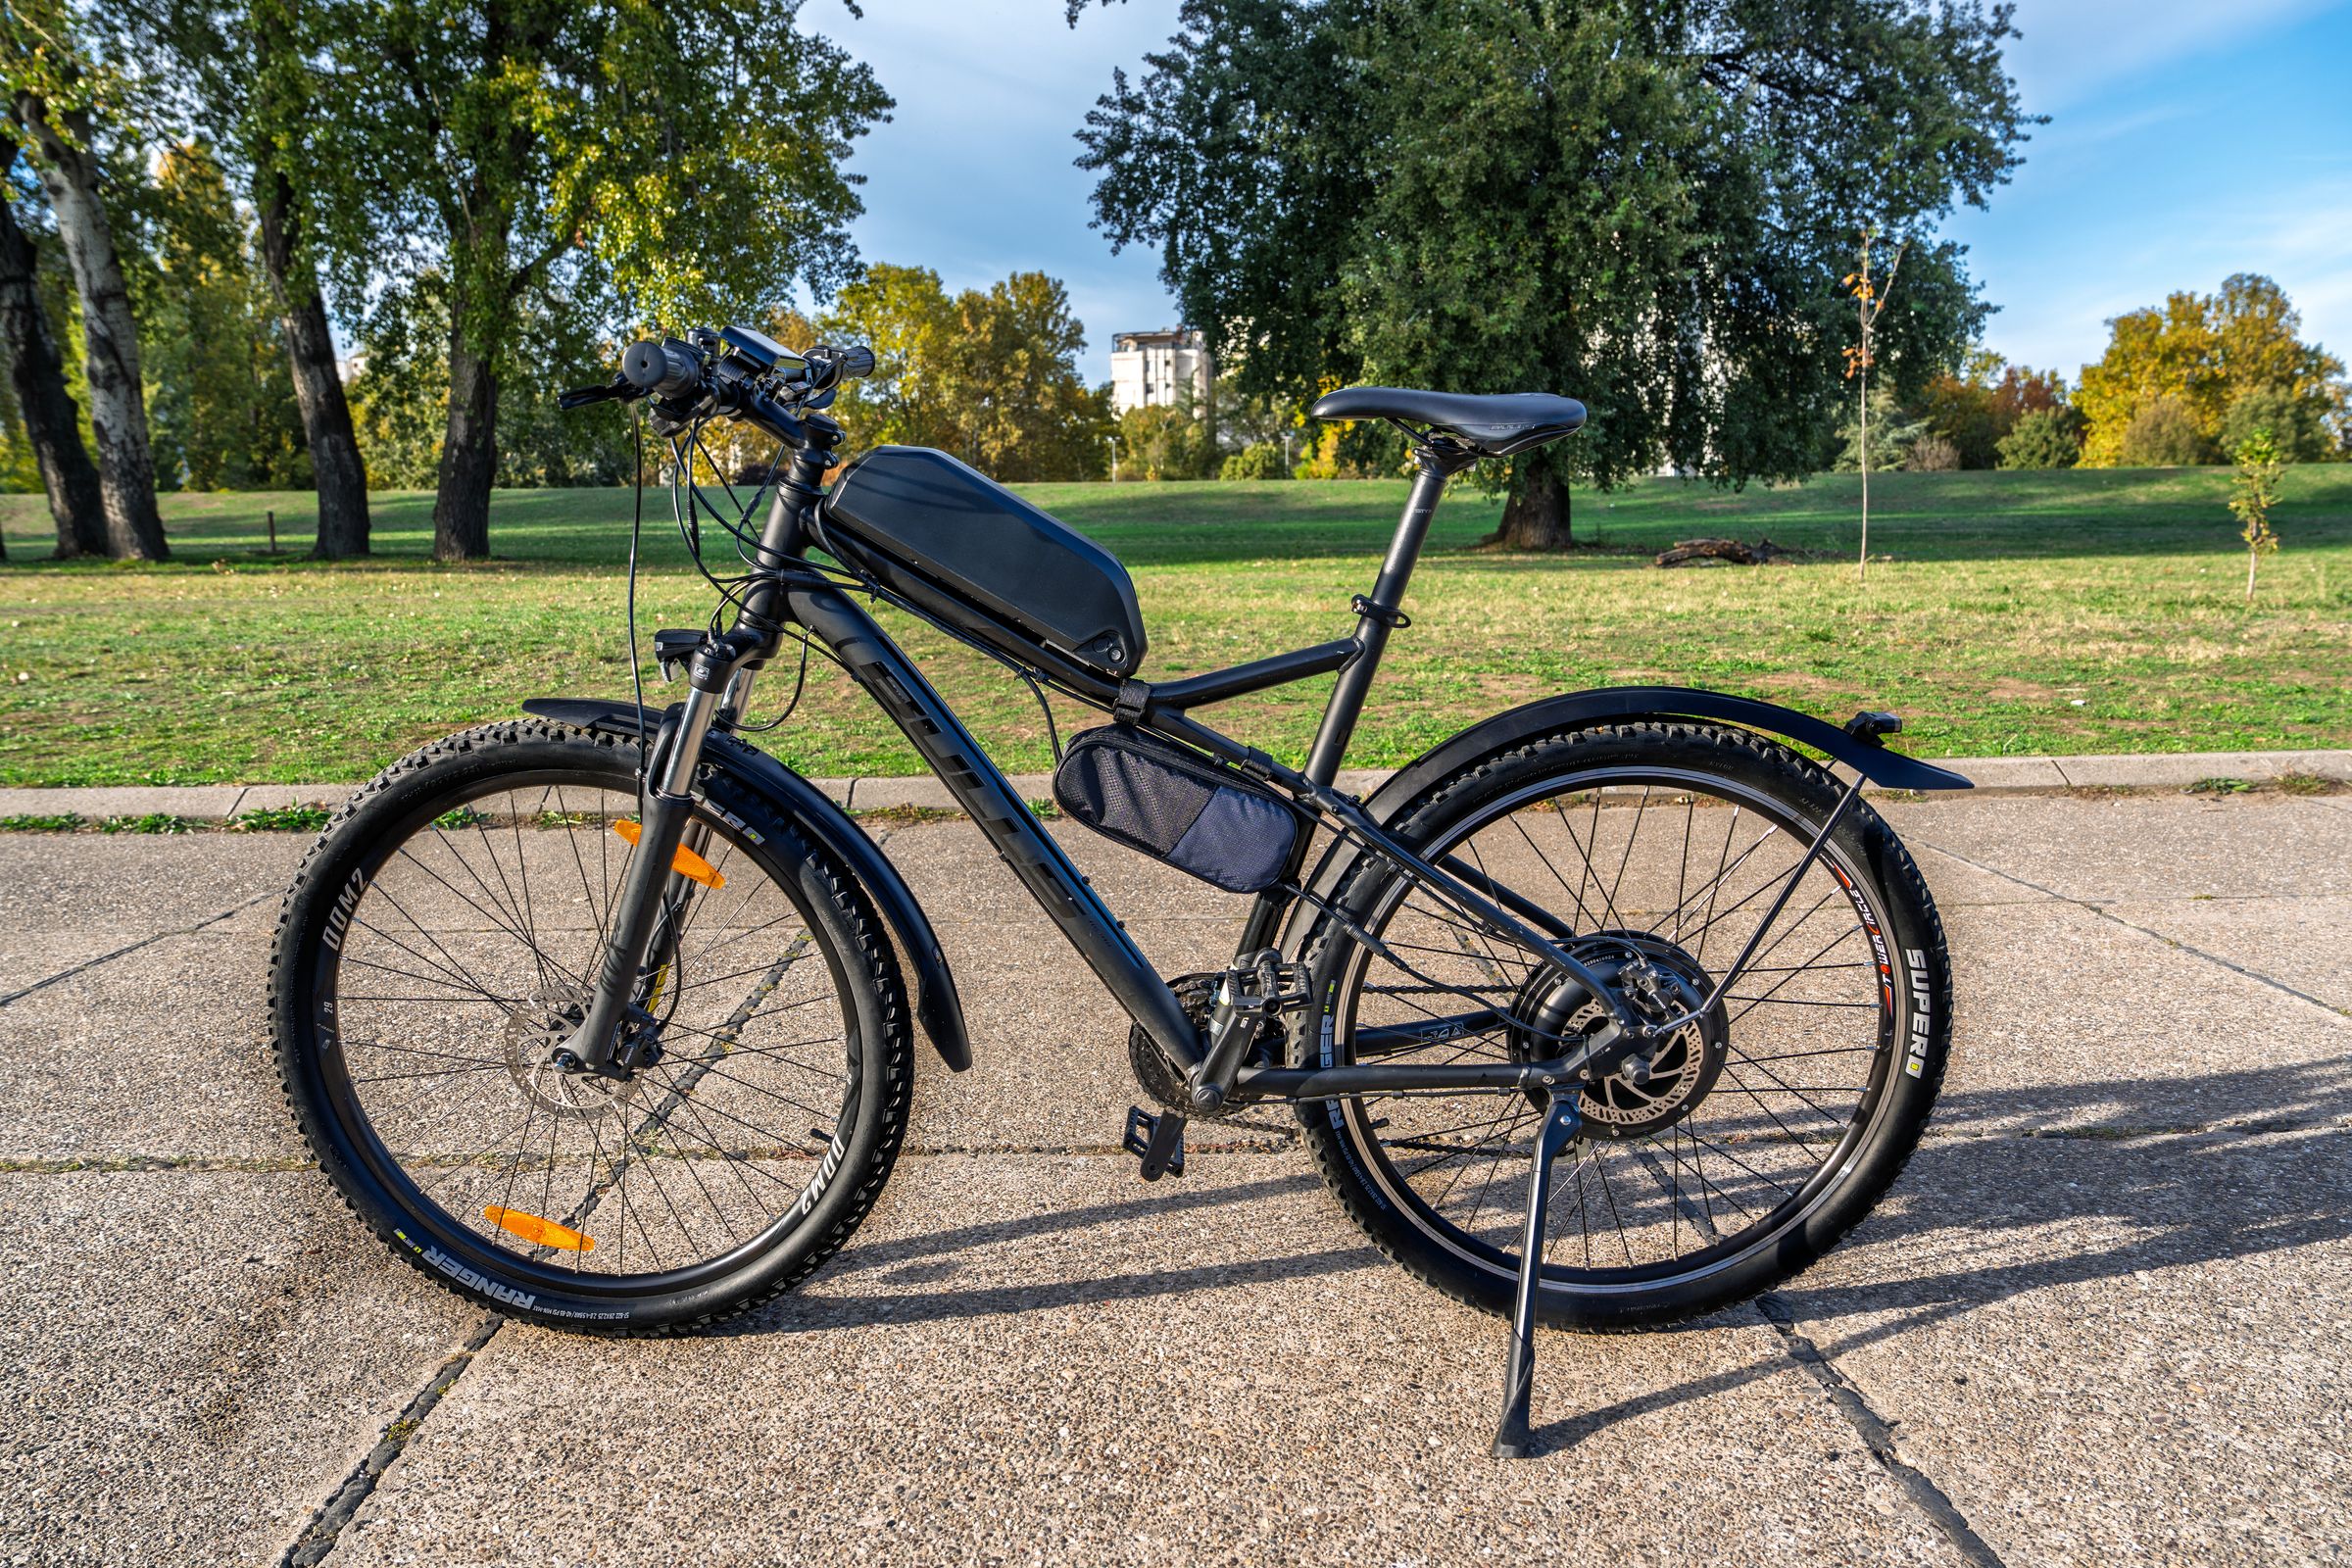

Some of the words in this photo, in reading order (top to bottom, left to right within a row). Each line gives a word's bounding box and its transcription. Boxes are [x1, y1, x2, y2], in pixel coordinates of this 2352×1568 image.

[323, 1001, 333, 1014] 29
[1905, 949, 1931, 1079] SUPERO
[421, 1245, 536, 1310] RANGER
